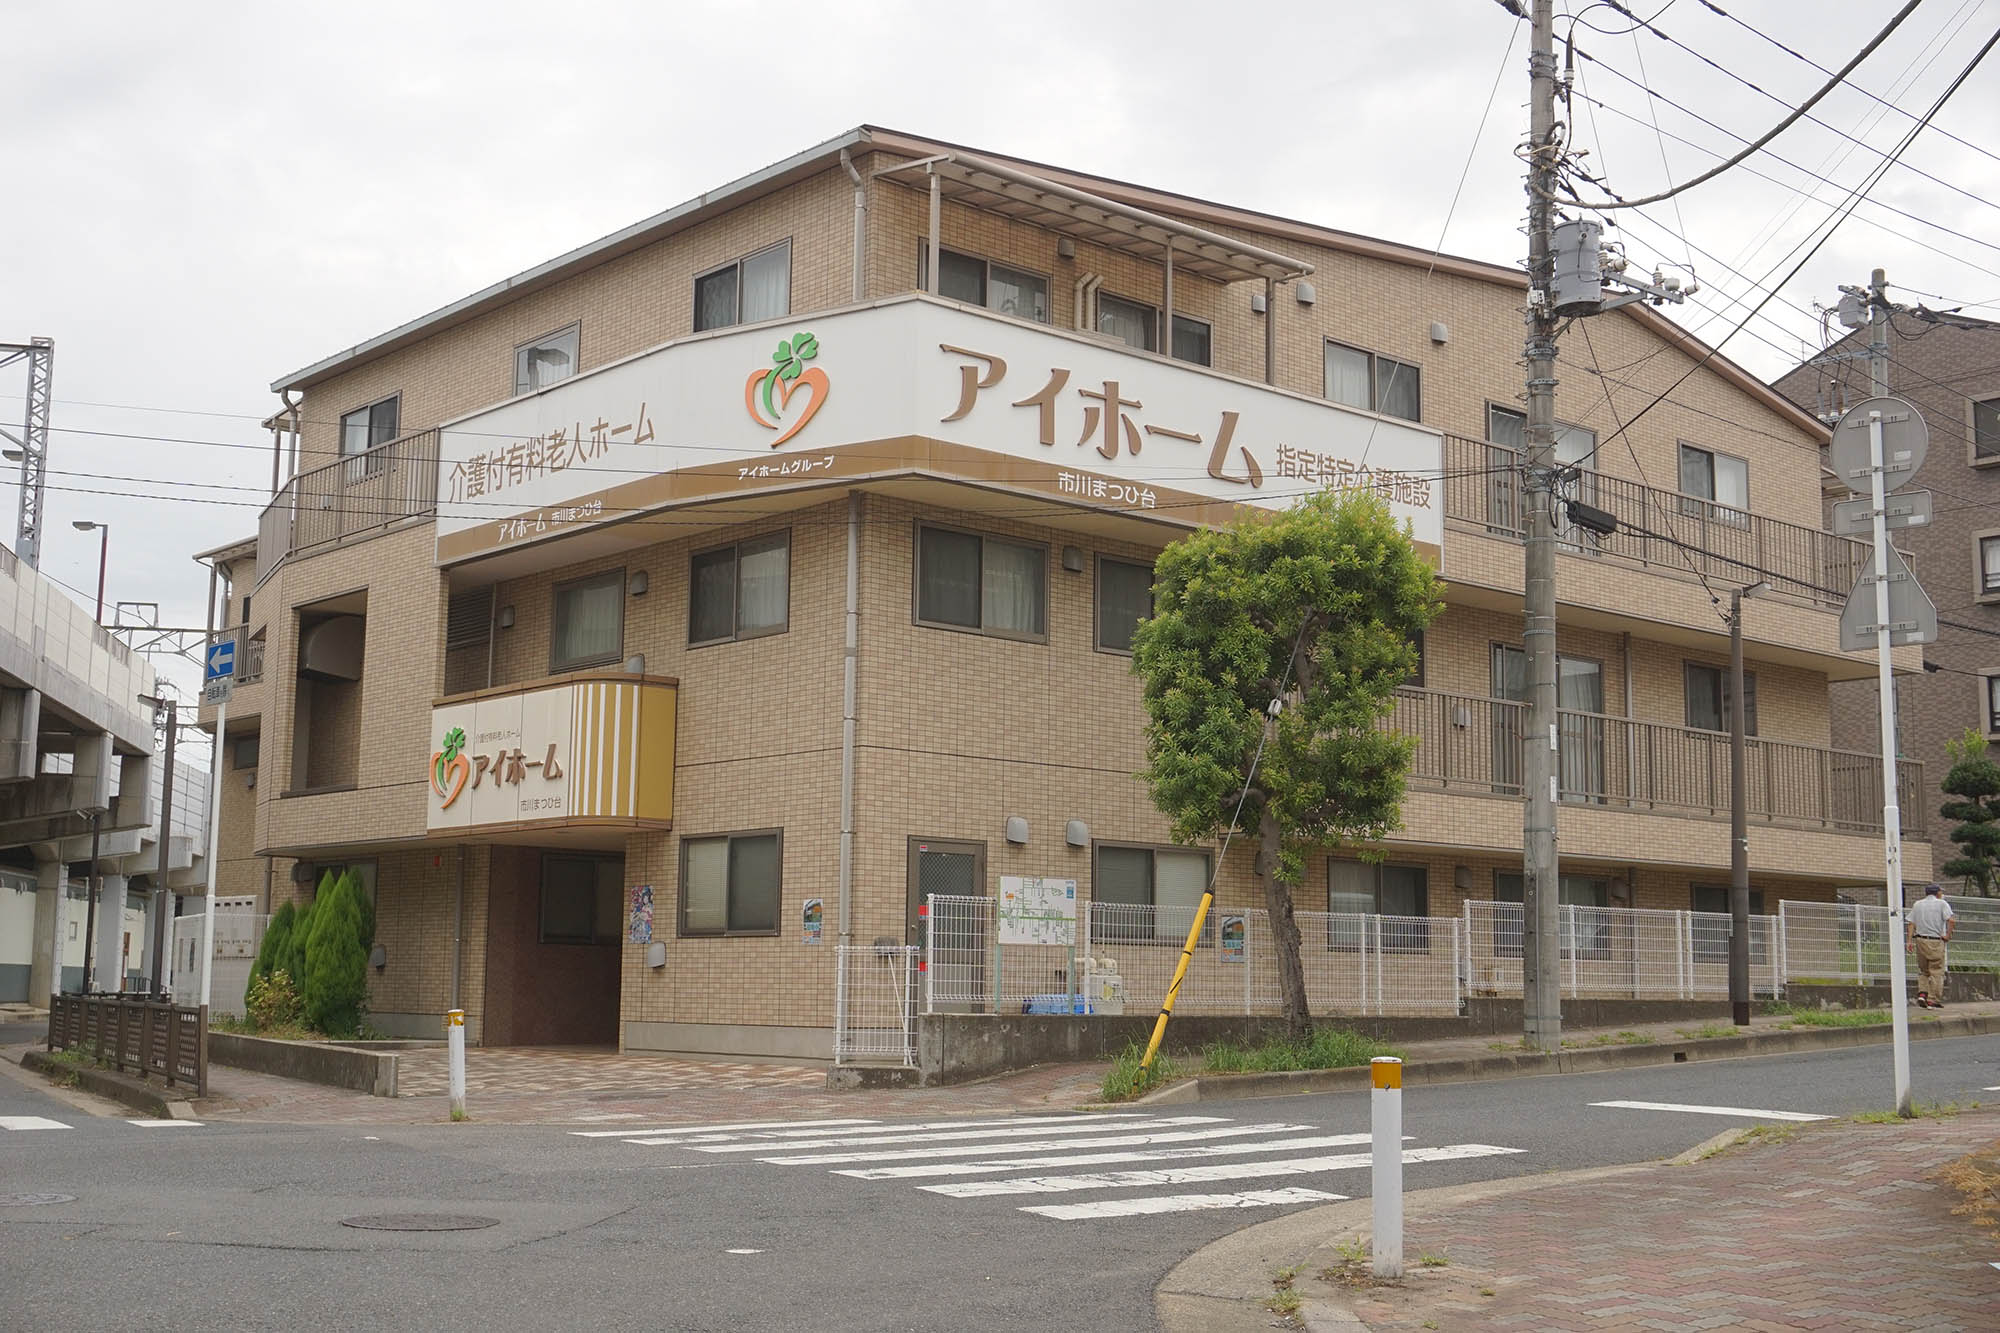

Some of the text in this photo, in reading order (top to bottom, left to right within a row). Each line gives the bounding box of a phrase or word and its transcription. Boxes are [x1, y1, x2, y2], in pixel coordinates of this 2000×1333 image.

[939, 343, 1263, 488] アイホーム
[449, 402, 654, 504] 介護付有料老人ホーム
[738, 455, 834, 480] アイホームグループ
[1058, 471, 1156, 509] 市川まつひ台
[1276, 443, 1431, 510] 指定特定介護施設
[498, 500, 602, 543] アイホーム 市川まつひ台
[472, 743, 563, 789] アイホーム
[521, 797, 561, 812] 市川まつひ台
